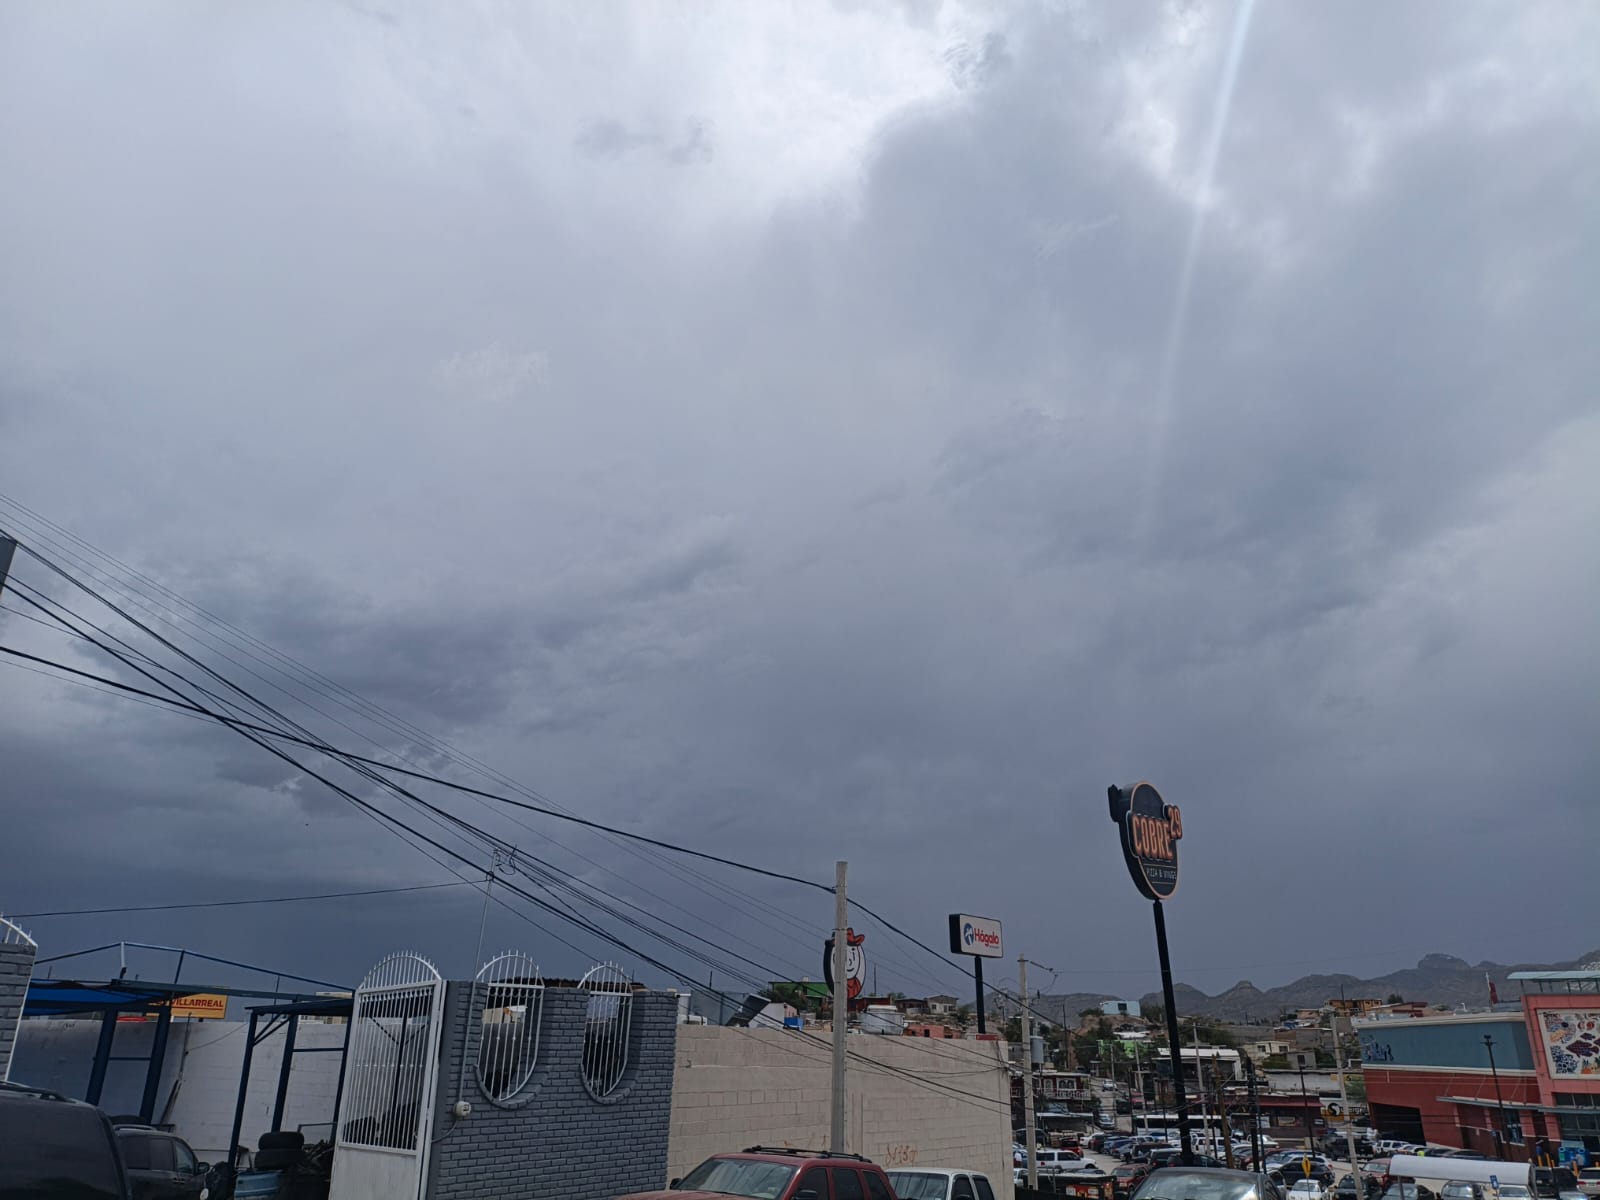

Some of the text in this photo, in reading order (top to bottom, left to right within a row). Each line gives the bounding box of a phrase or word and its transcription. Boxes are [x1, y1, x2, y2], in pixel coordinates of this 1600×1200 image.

[1132, 806, 1182, 859] COBRE 29
[974, 928, 1000, 947] Hágalo
